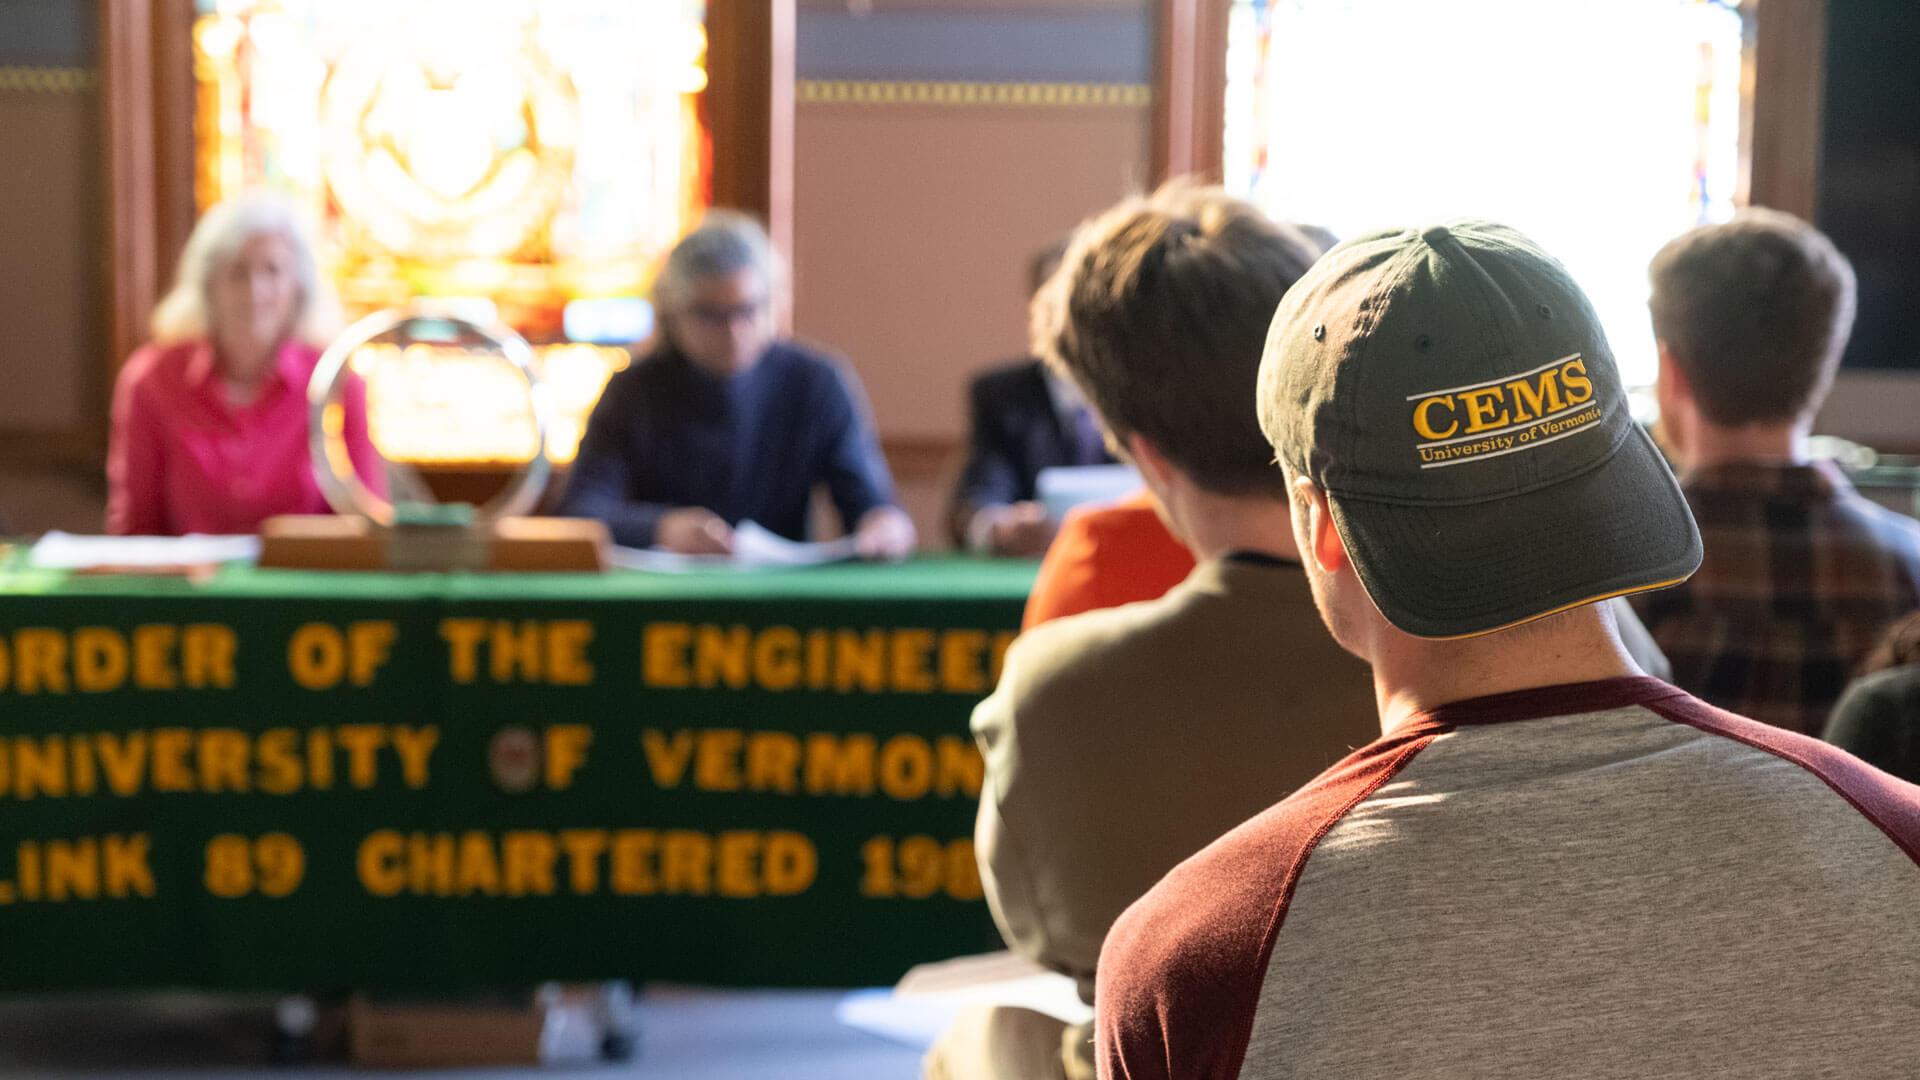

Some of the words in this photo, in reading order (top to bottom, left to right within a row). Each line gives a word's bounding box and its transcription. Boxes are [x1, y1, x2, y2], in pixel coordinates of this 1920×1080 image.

[1413, 358, 1593, 440] CEMS
[1419, 434, 1514, 463] University
[1520, 426, 1537, 442] of
[1539, 406, 1600, 435] Vermont
[0, 624, 237, 694] RDER
[288, 621, 396, 690] OF
[440, 618, 593, 684] THE
[0, 725, 438, 797] NIVERSITY
[0, 834, 154, 902] INK
[205, 833, 304, 897] 89
[357, 829, 817, 898] CHARTERED
